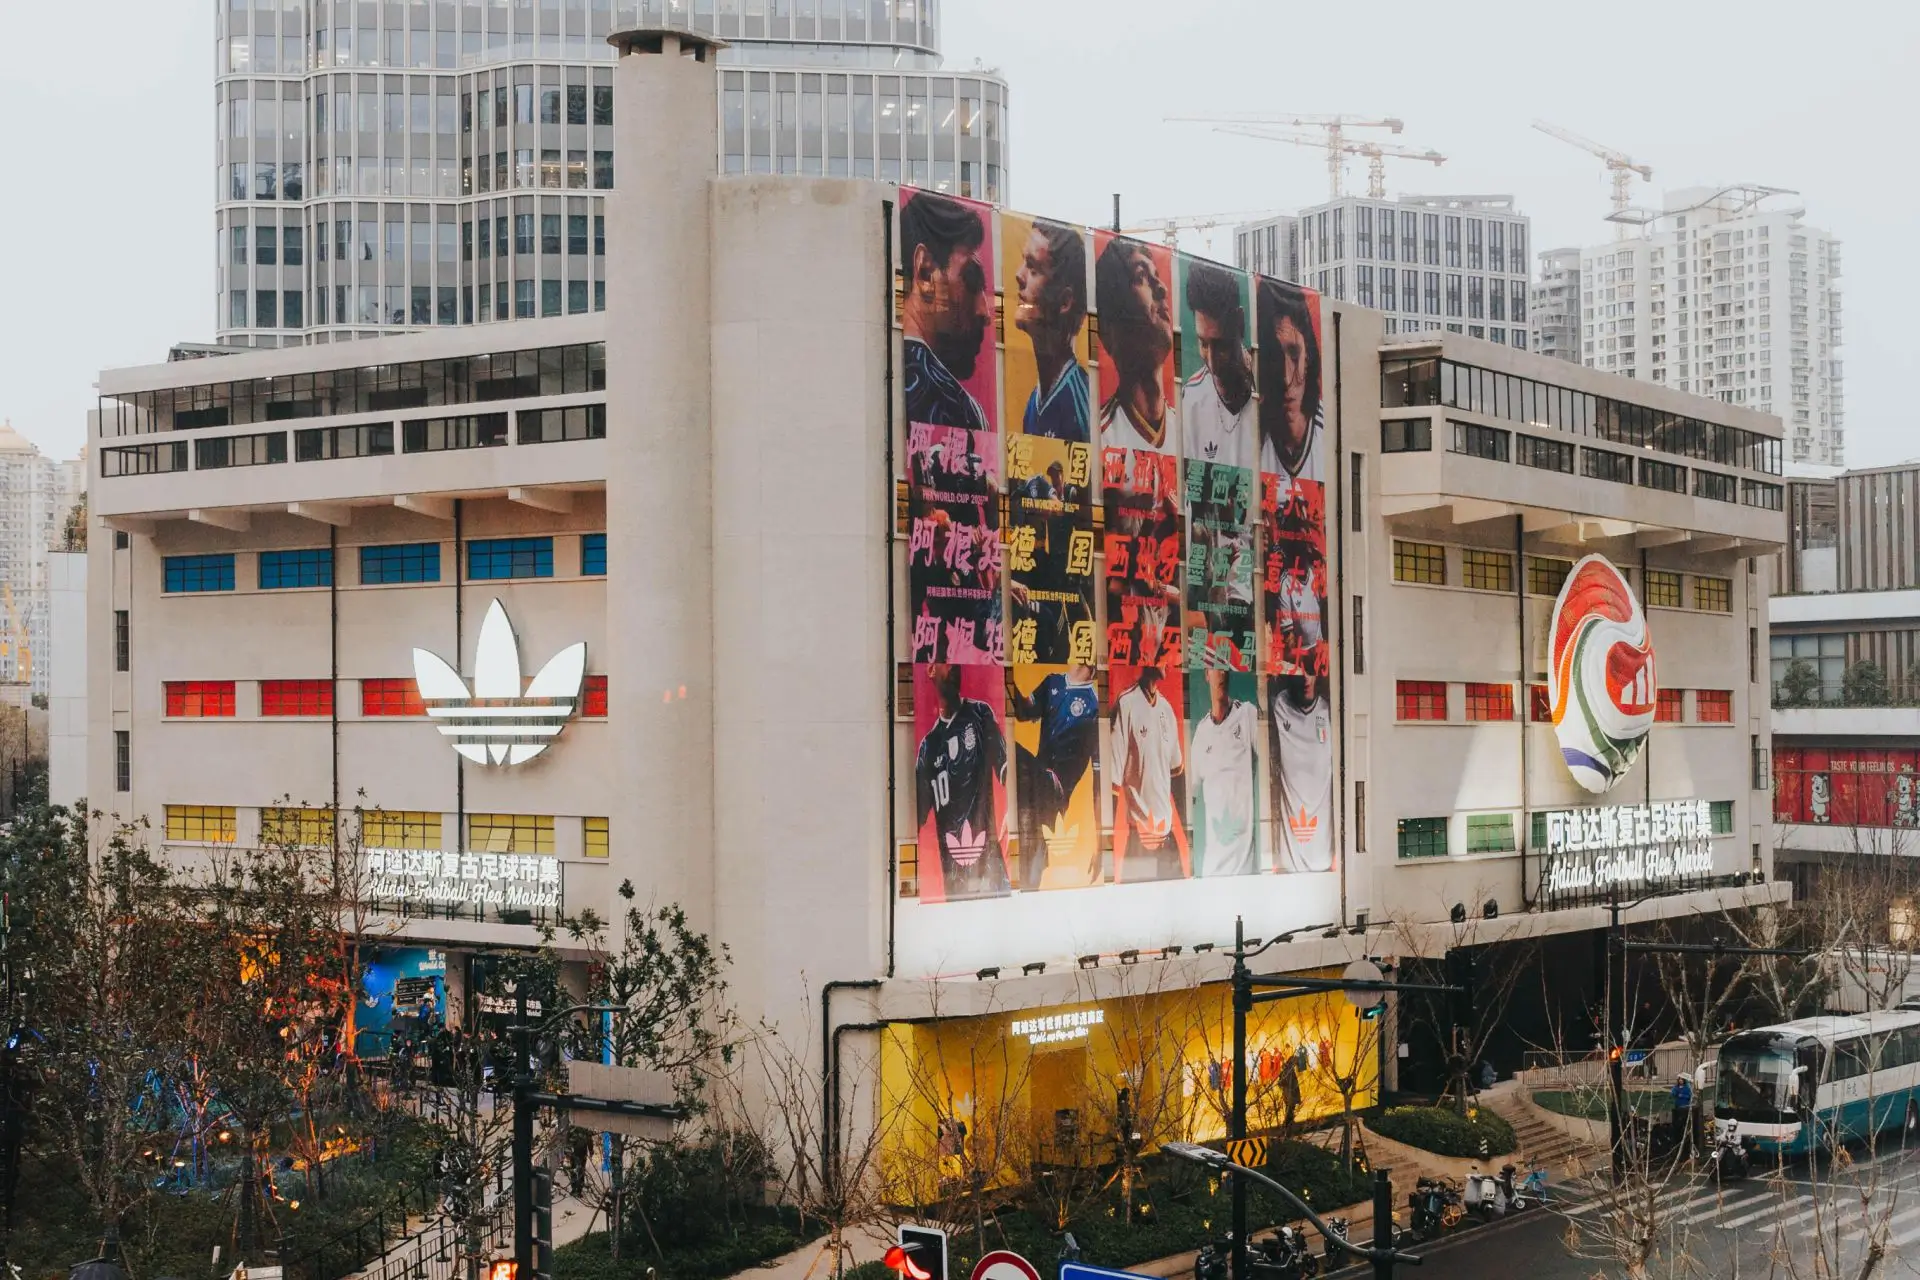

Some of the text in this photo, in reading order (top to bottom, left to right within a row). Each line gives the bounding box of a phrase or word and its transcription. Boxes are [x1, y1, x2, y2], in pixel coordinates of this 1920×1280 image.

[933, 491, 954, 502] WORLD
[956, 493, 969, 503] CUP
[909, 517, 1001, 571] 阿根廷
[1830, 760, 1847, 771] TASTE
[1850, 761, 1866, 772] YOUR
[931, 770, 949, 812] 10
[1546, 800, 1712, 854] 阿迪达斯复古足球市集
[367, 848, 560, 884] 阿迪达斯复古足球市集
[1549, 843, 1713, 893] Adidas Football Flea Market
[368, 877, 560, 907] Adidas Football Flea Market
